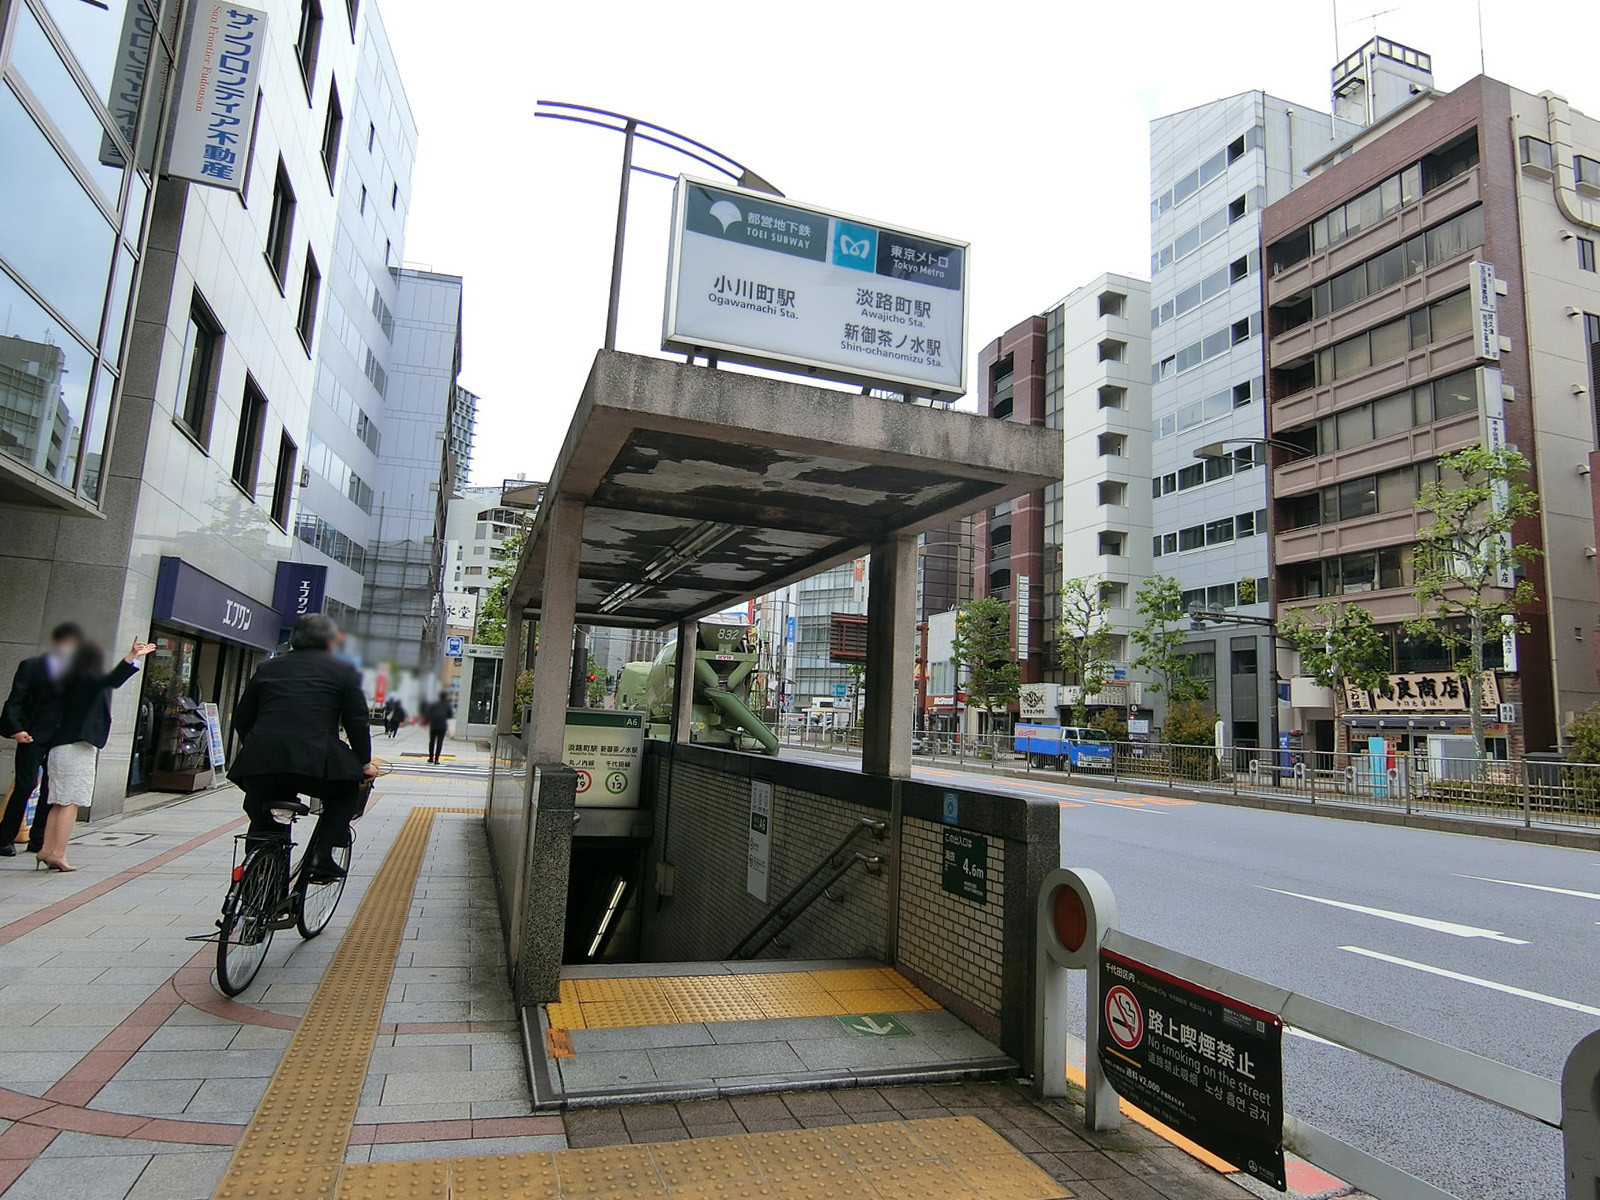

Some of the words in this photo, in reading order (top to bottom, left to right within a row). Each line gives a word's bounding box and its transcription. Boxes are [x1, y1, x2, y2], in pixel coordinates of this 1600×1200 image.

[209, 5, 222, 24] Sun
[203, 26, 219, 64] Frontier
[195, 66, 212, 112] Fudousan
[201, 9, 259, 181] サンフロンティア不動産
[747, 211, 812, 238] 都営地下鉄
[746, 226, 768, 241] TOEI
[771, 231, 811, 250] SUBWAY
[889, 244, 949, 269] 東京メトロ
[893, 259, 918, 276] Tokyo
[919, 264, 945, 279] Metro
[712, 273, 796, 309] 小川町駅
[855, 287, 932, 320] 淡路町駅
[708, 292, 777, 317] Ogawamachi
[779, 306, 799, 321] Sta.
[860, 308, 906, 326] Awajicho
[907, 316, 926, 329] Sta.
[844, 322, 942, 358] 新御茶ノ水駅
[840, 339, 924, 366] Shin-ochanomizu
[925, 354, 944, 369] Sta.
[297, 580, 311, 614] エフワン
[222, 598, 253, 631] エフワン
[717, 627, 739, 641] 832
[626, 718, 638, 726] A6
[567, 744, 598, 752] 淡路町駅
[600, 745, 638, 754] 新御茶ノ水駅
[568, 759, 595, 767] 丸ノ内線
[605, 760, 631, 768] 千代田線
[611, 782, 622, 790] 12
[962, 857, 984, 879] 4.6m
[1104, 961, 1136, 984] 千代田区内
[1147, 1007, 1257, 1081] 路上喫煙禁止
[1147, 1034, 1160, 1051] No
[1161, 1042, 1201, 1074] smoking
[1203, 1064, 1217, 1081] on
[1217, 1069, 1237, 1090] the
[1237, 1078, 1272, 1108] street
